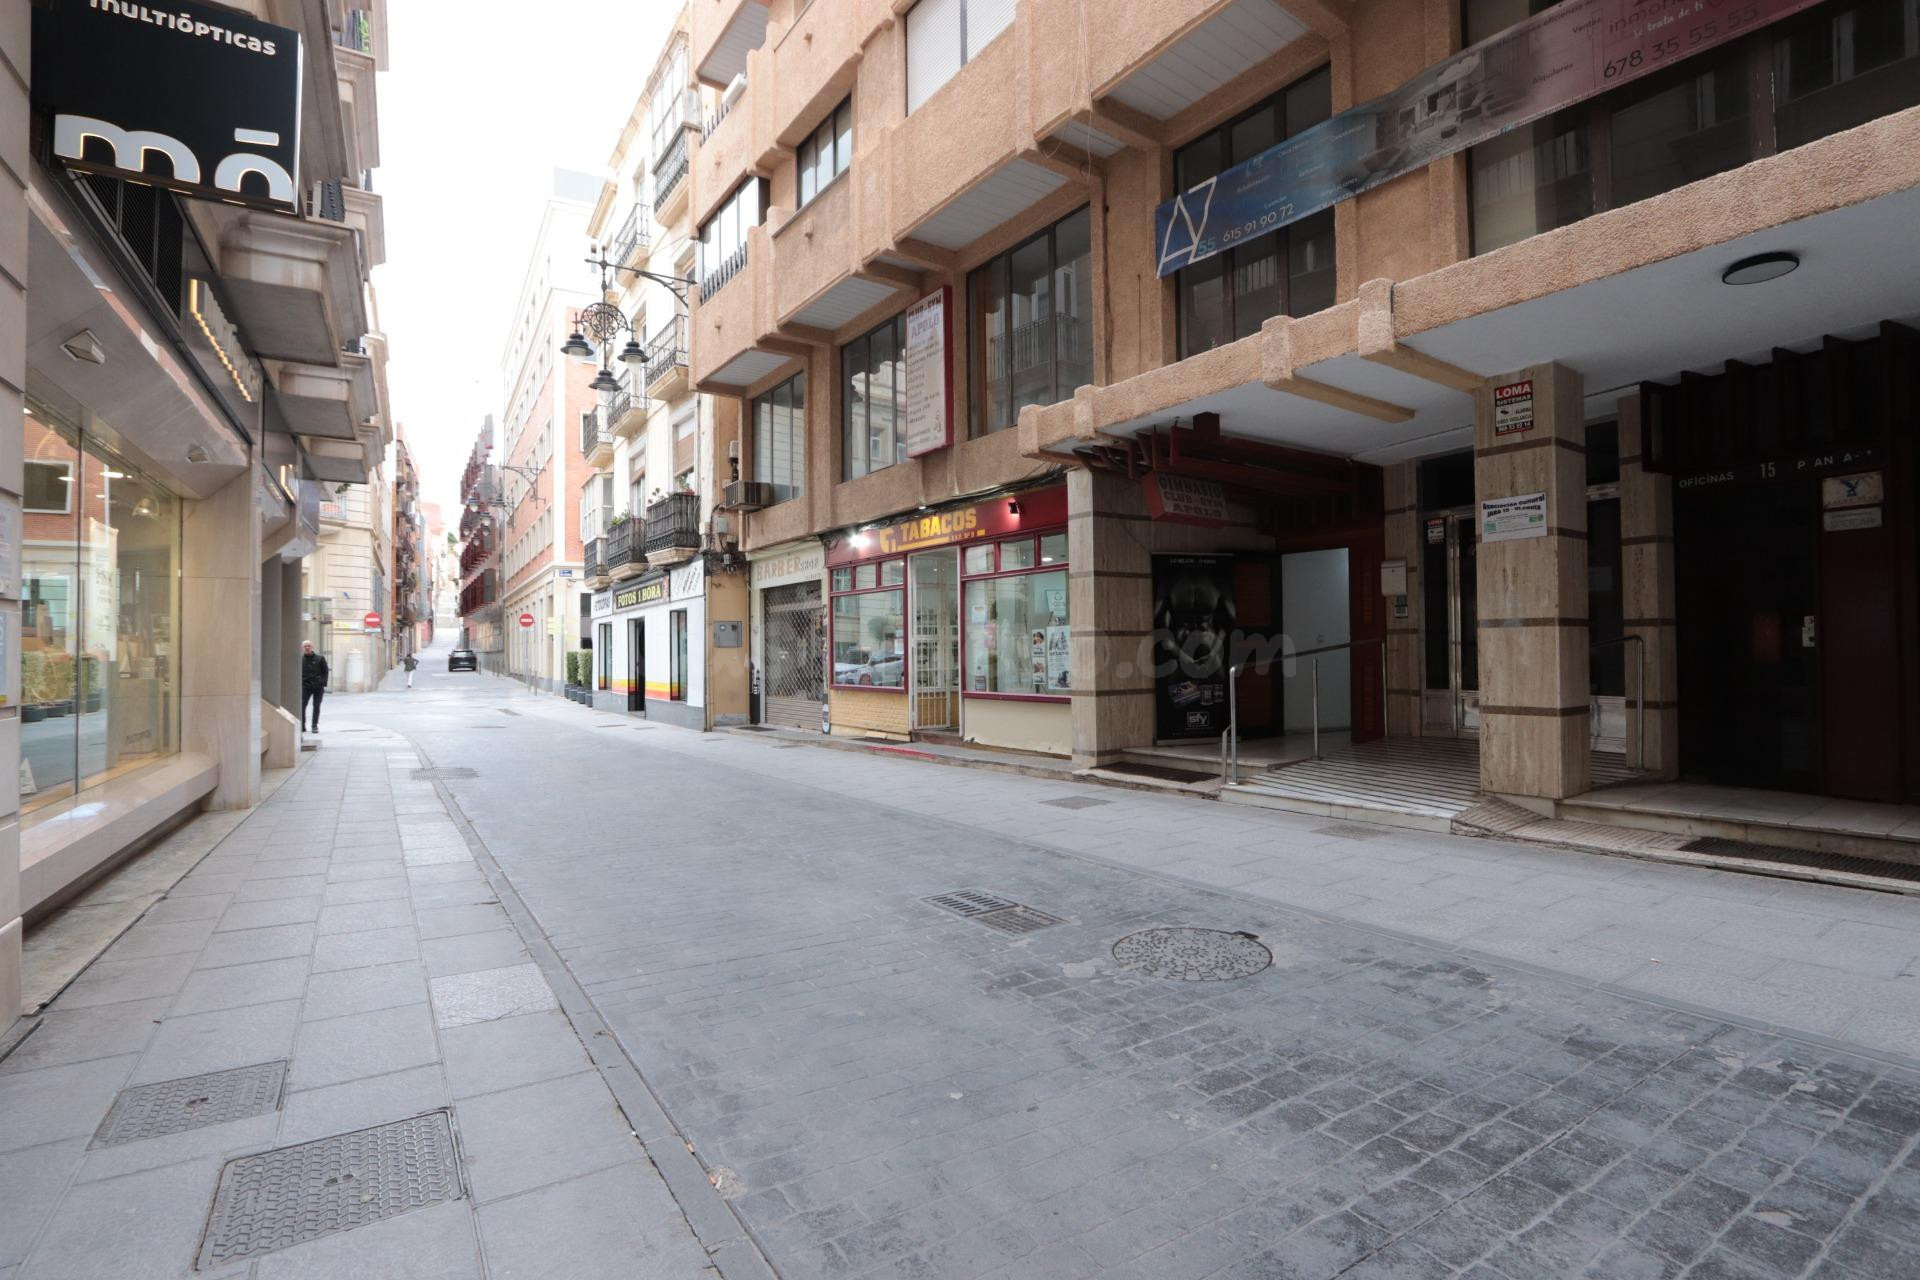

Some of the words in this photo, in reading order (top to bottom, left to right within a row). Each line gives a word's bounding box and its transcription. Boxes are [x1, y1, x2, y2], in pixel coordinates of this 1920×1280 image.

[1604, 50, 1643, 78] 678
[1652, 37, 1680, 61] 35
[1688, 21, 1718, 45] 55
[1728, 4, 1760, 29] 55
[1222, 228, 1242, 242] 615
[1244, 221, 1257, 234] 91
[1260, 212, 1276, 228] 90
[1279, 203, 1295, 219] 72
[1496, 383, 1531, 399] LOMA
[1678, 471, 1735, 489] OFICINAS
[1760, 461, 1776, 479] 15
[1173, 503, 1222, 518] APOLO
[900, 508, 977, 542] TABACOS
[757, 556, 800, 581] BARBER
[617, 591, 637, 607] FOTOS
[638, 590, 642, 602] 1
[642, 584, 661, 600] HORA
